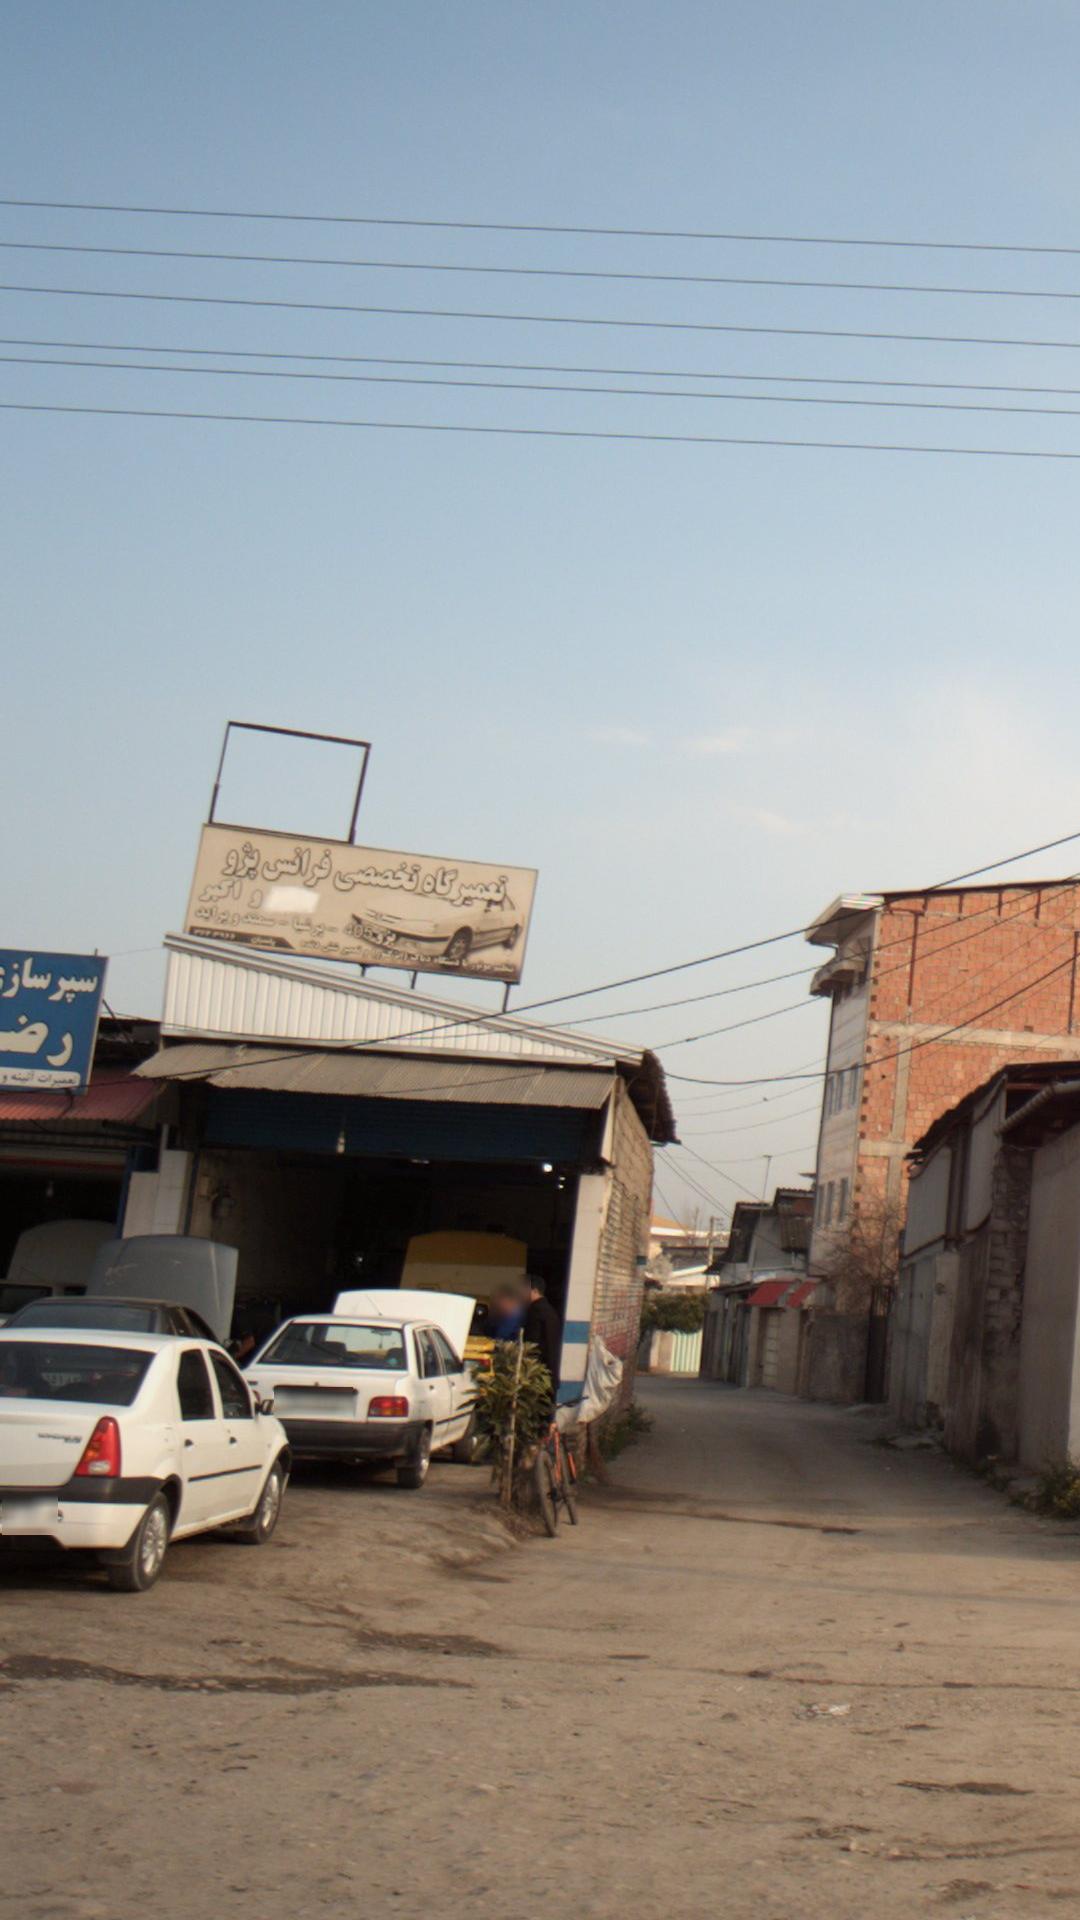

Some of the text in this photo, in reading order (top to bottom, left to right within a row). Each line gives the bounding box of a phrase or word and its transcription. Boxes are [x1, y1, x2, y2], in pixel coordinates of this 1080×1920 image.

[222, 842, 260, 880] پژو
[261, 847, 332, 887] فرانس
[333, 862, 421, 892] تخصصی
[199, 878, 263, 909] و اکبر
[195, 906, 229, 924] پراید
[48, 974, 99, 1003] سپر
[0, 1014, 74, 1067] رض
[38, 1074, 76, 1086] تعمیرات
